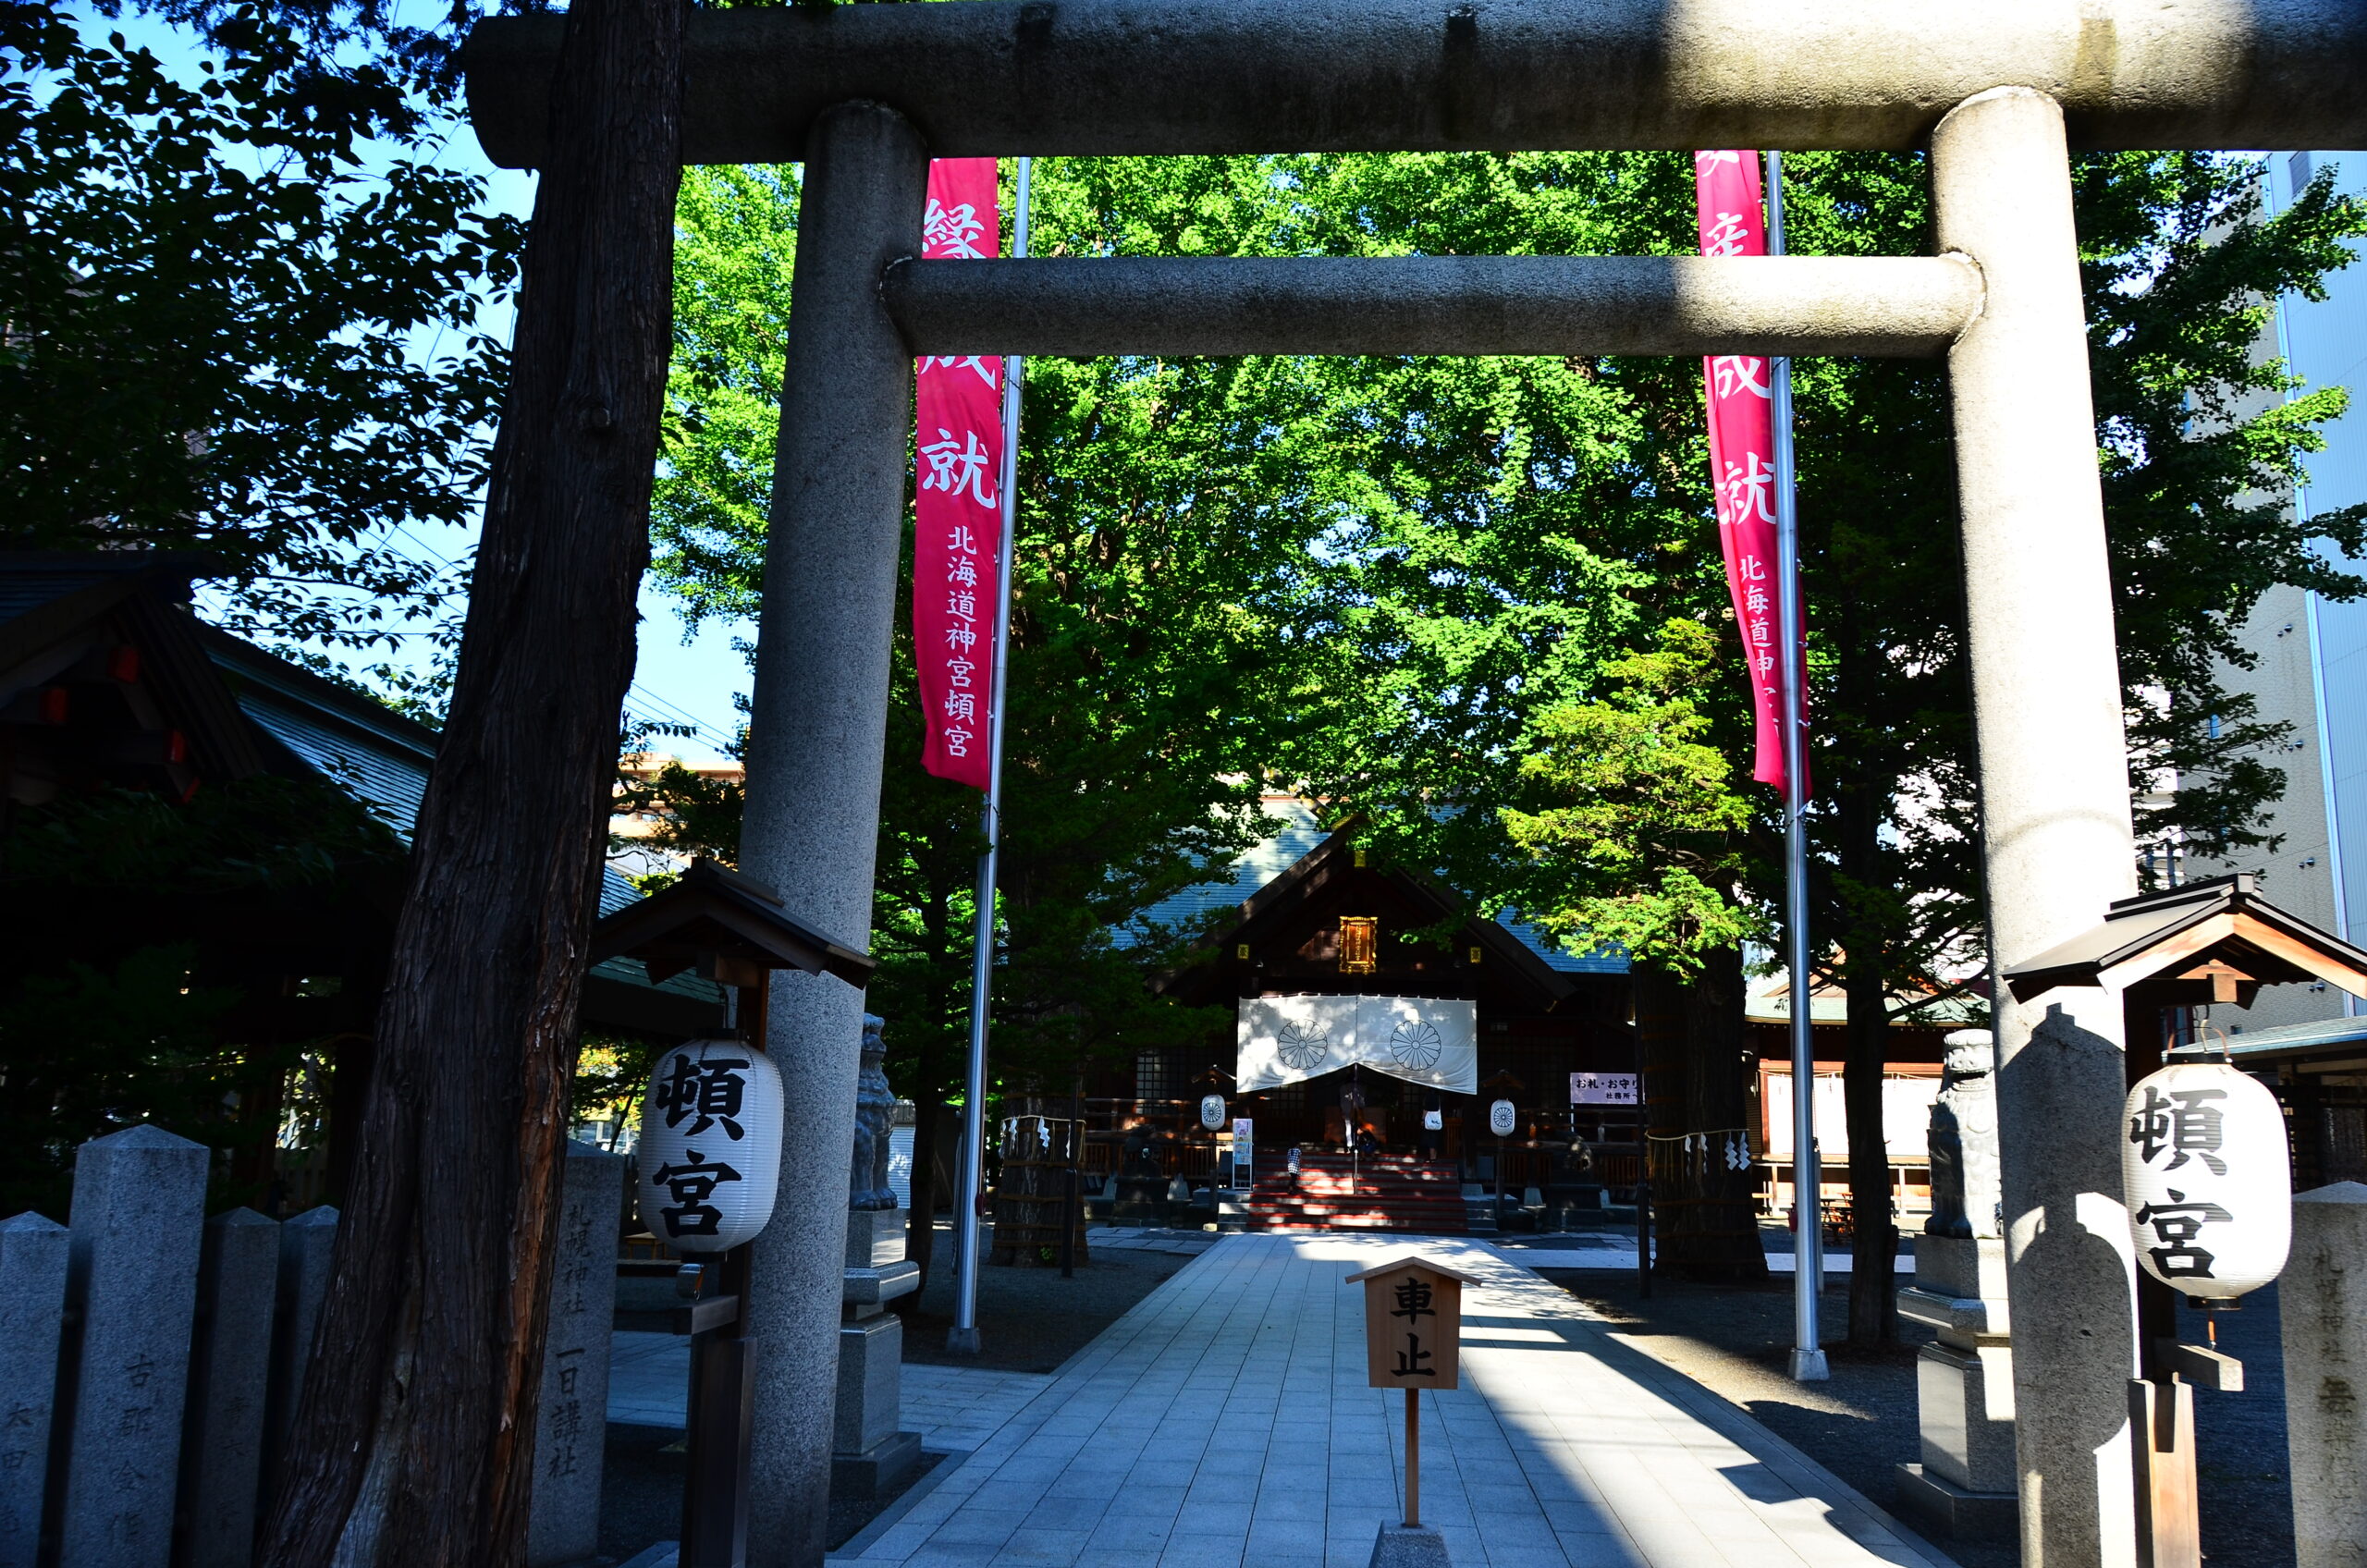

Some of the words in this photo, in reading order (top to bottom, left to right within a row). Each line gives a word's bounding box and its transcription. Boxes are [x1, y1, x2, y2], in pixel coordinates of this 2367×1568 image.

[944, 525, 977, 757] 北海道神宮頓宮
[652, 1053, 750, 1238] 頓宮
[2129, 1085, 2234, 1280] 頓宮
[562, 1205, 592, 1317] 札幌神社
[1391, 1277, 1436, 1377] 車止
[548, 1347, 586, 1478] 一日講社
